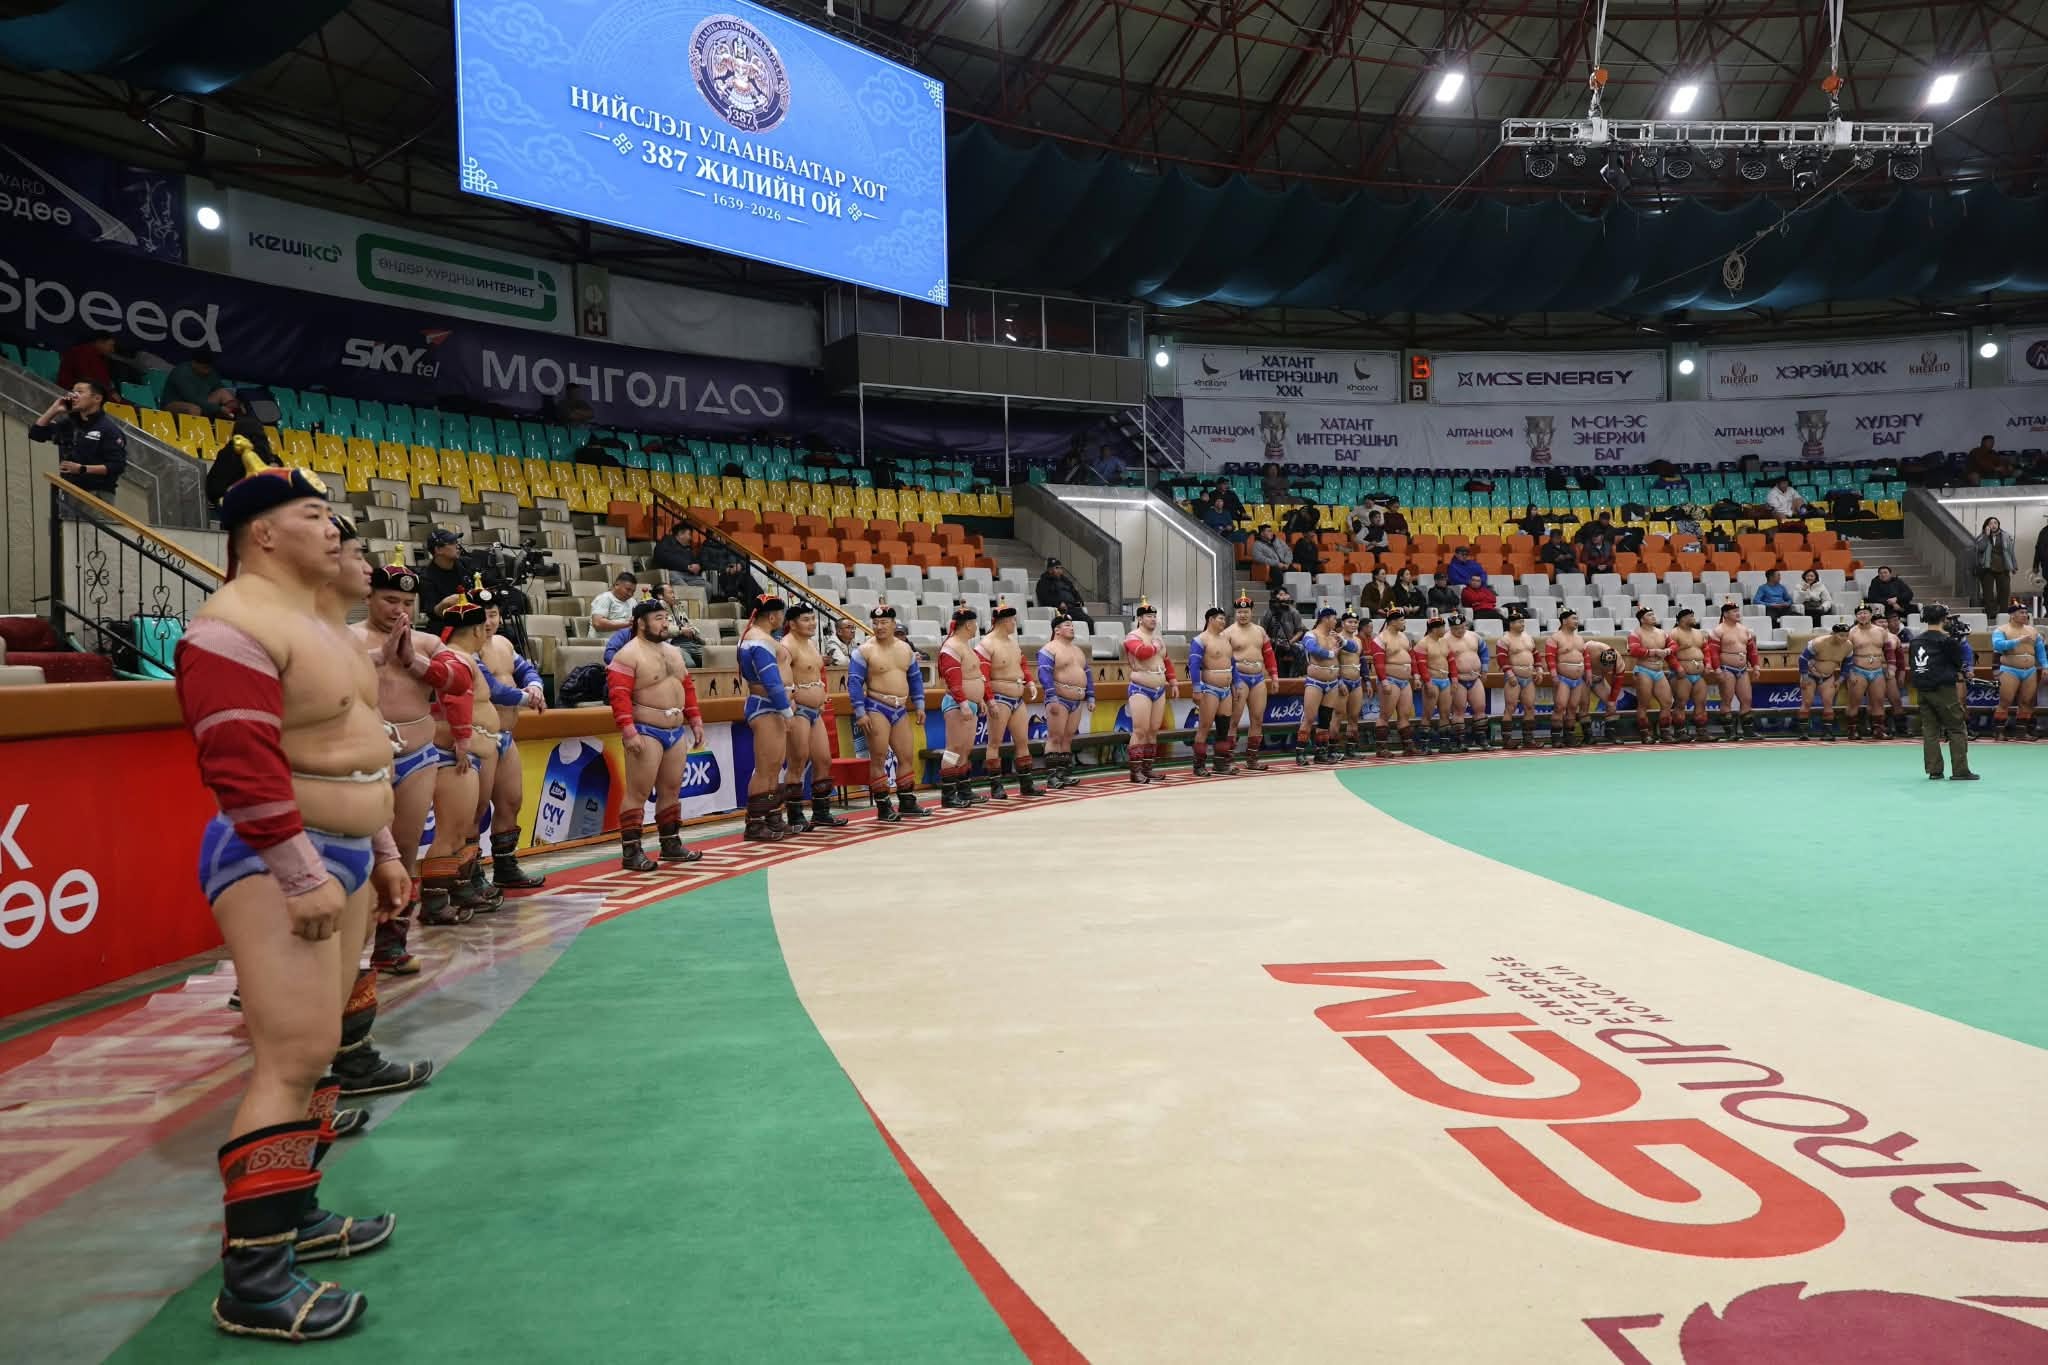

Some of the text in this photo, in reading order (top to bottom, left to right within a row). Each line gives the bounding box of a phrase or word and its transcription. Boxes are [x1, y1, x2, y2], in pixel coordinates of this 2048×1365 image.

[732, 109, 753, 125] 387
[570, 86, 888, 202] НИЙСЛЭЛ УЛААНБААТАР ХОТ
[641, 139, 842, 218] 387 ЖИЛИЙН ОЙ
[712, 192, 782, 222] 1639-2026
[378, 255, 423, 274] ӨНДӨР
[476, 278, 537, 298] ИНТЕРНЕТ
[1261, 355, 1315, 369] ХАТАНТ
[1776, 360, 1888, 380] ХЭРЭЙД ХХК
[482, 349, 687, 411] МОНГОЛ
[1239, 368, 1339, 384] ИНТЕРНЭШНЛ
[1476, 370, 1633, 387] MCS ENERGY
[1276, 384, 1304, 398] ХХК
[1320, 417, 1375, 432] ХАТАНТ
[1571, 414, 1648, 429] М-СИ-ЭС
[1855, 413, 1923, 431] ХҮЛЭГҮ
[1190, 425, 1255, 438] АЛТАН ЦОМ
[1446, 427, 1513, 439] АЛТАН ЦОМ
[1573, 431, 1646, 445] ЭНЕРЖИ
[1714, 426, 1785, 438] АЛТАН ЦОМ
[1872, 431, 1907, 446] БАГ
[1296, 433, 1399, 448] ИНТЕРНЭШНЛ
[1334, 449, 1361, 462] БАГ
[1594, 447, 1625, 461] БАГ
[1485, 971, 1592, 1025] GENERAL
[1491, 956, 1635, 1025] ENTERPRISE
[1544, 965, 1673, 1023] MONGOLIA
[1595, 1028, 2048, 1243] GROUP
